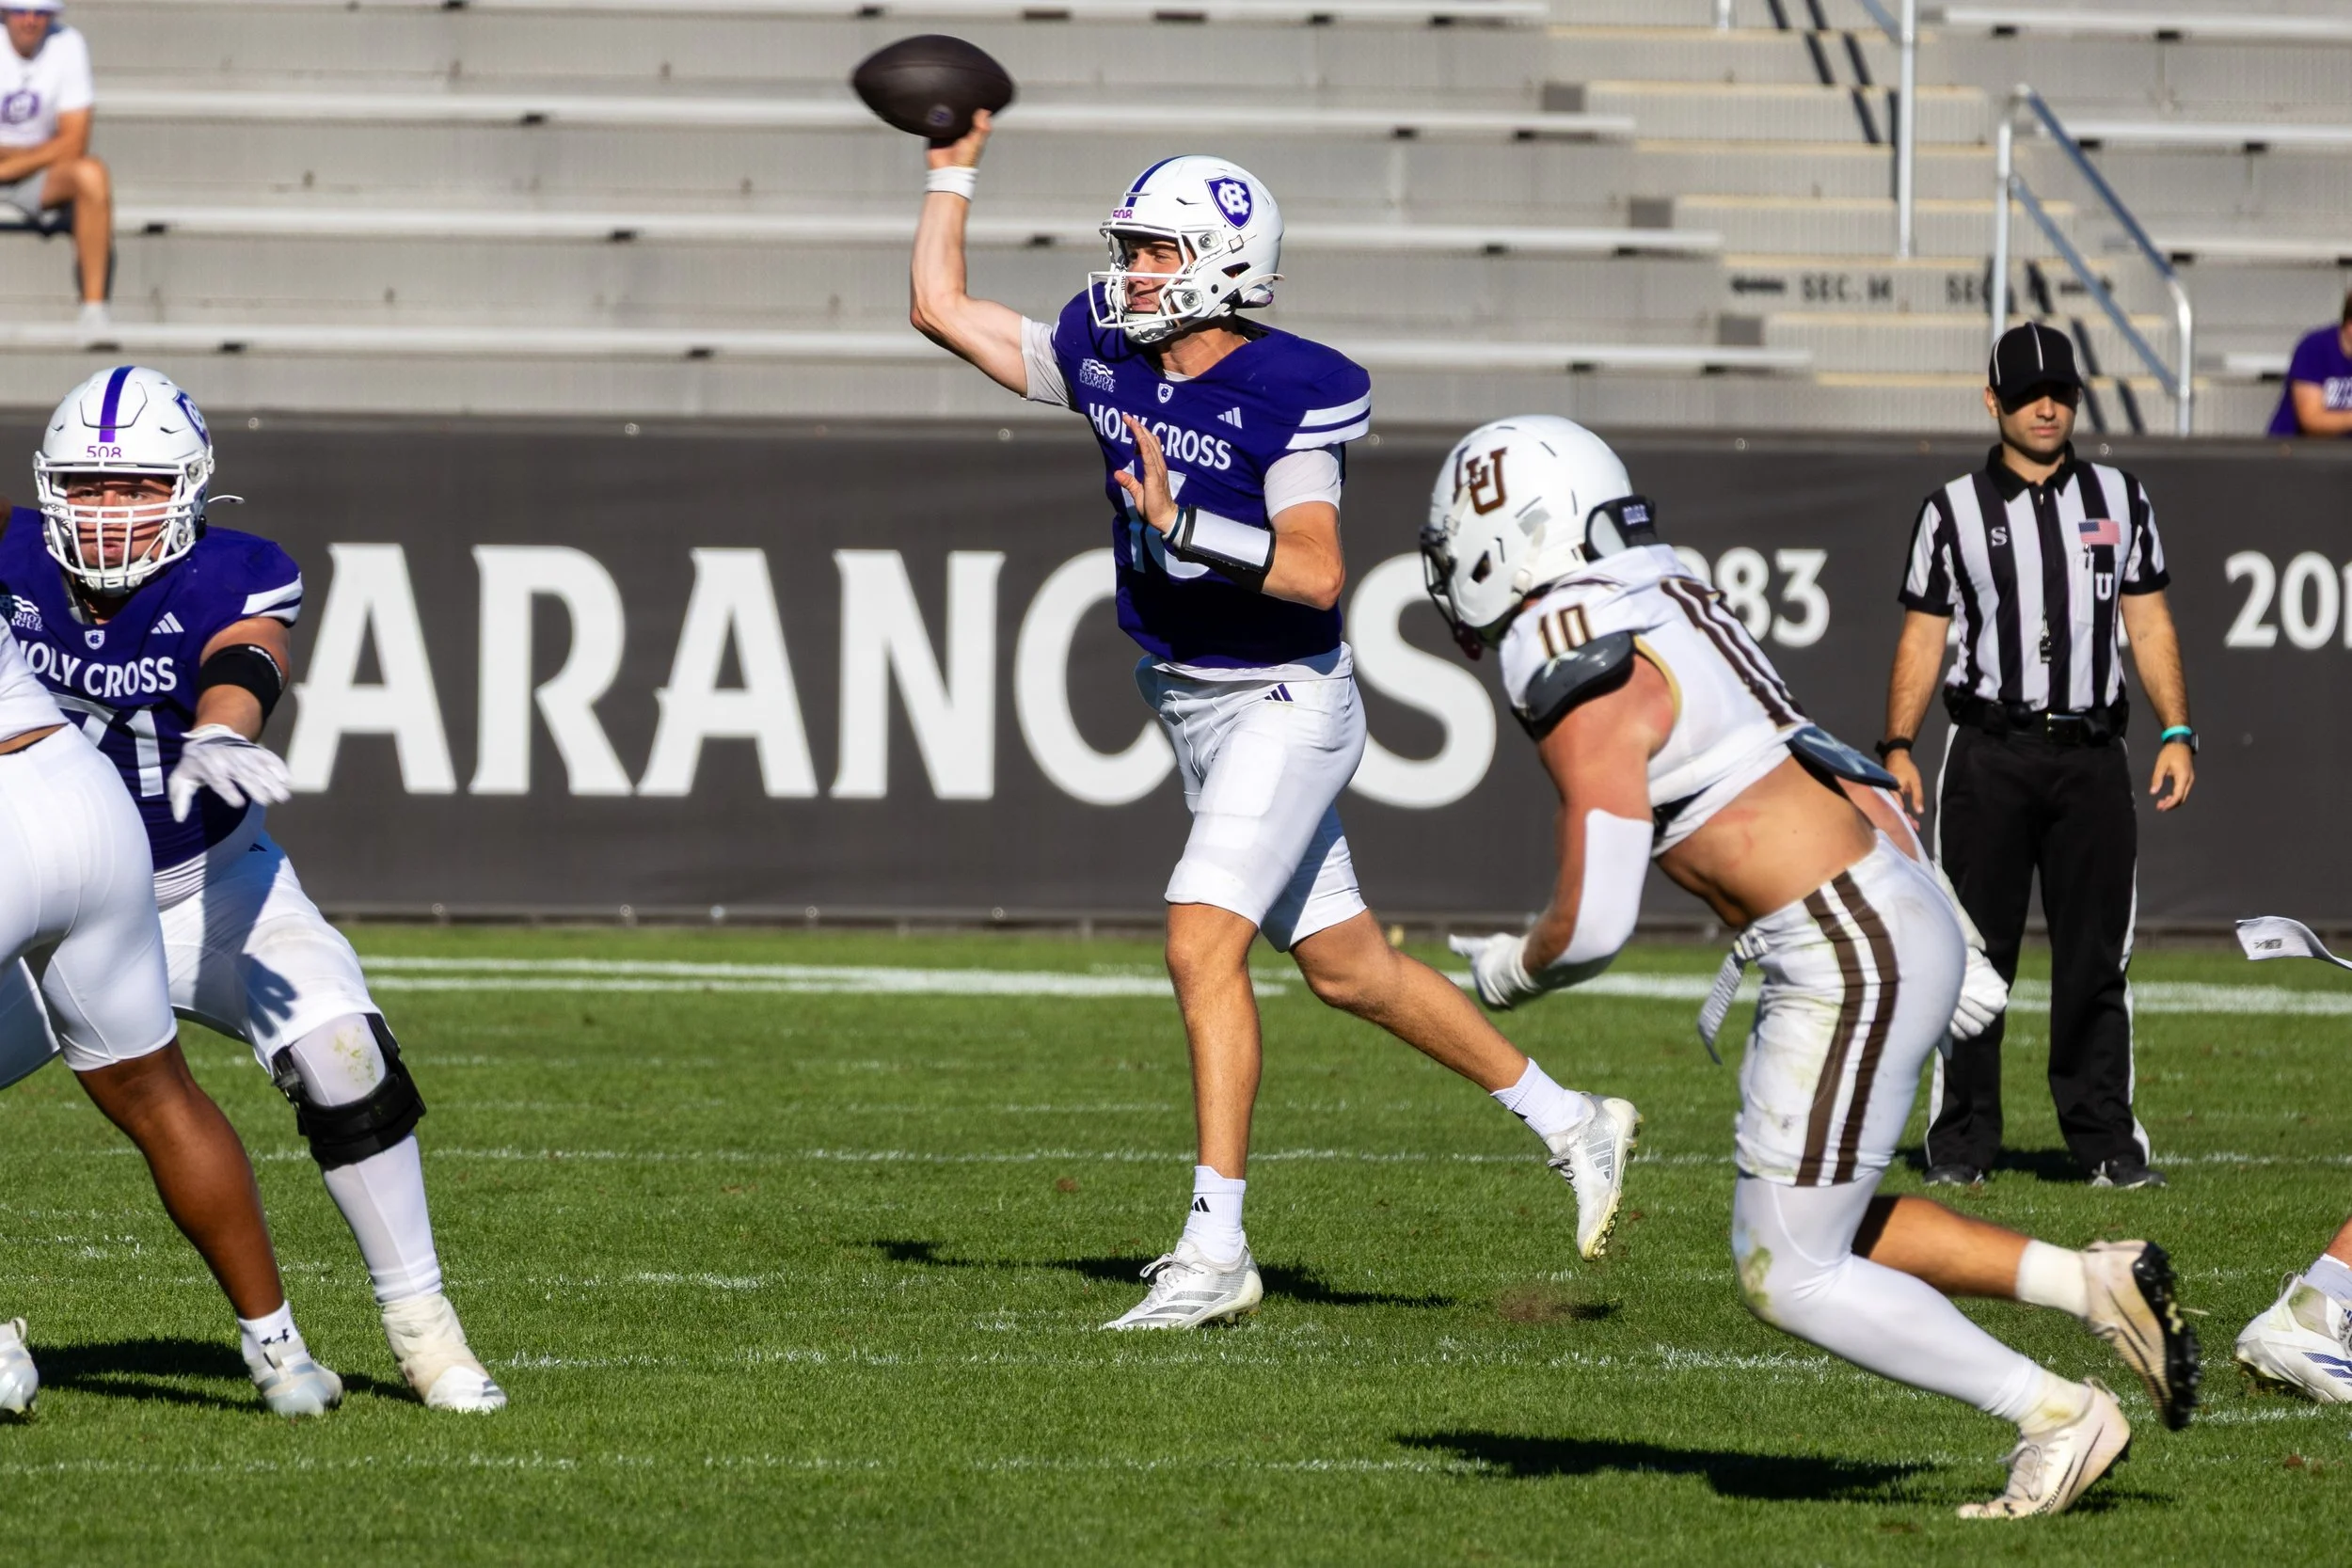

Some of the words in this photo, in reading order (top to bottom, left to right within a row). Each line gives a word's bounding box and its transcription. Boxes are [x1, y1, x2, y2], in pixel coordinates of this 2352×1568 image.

[1079, 369, 1116, 386] PATRIOT
[1079, 376, 1114, 393] LEAGUE
[86, 445, 121, 458] 508
[1152, 421, 1232, 470] CROSS
[1991, 526, 2008, 546] S
[2095, 572, 2114, 600] U
[1536, 601, 1595, 660] 10
[84, 657, 177, 698] CROSS
[287, 543, 1498, 808] ARANCS
